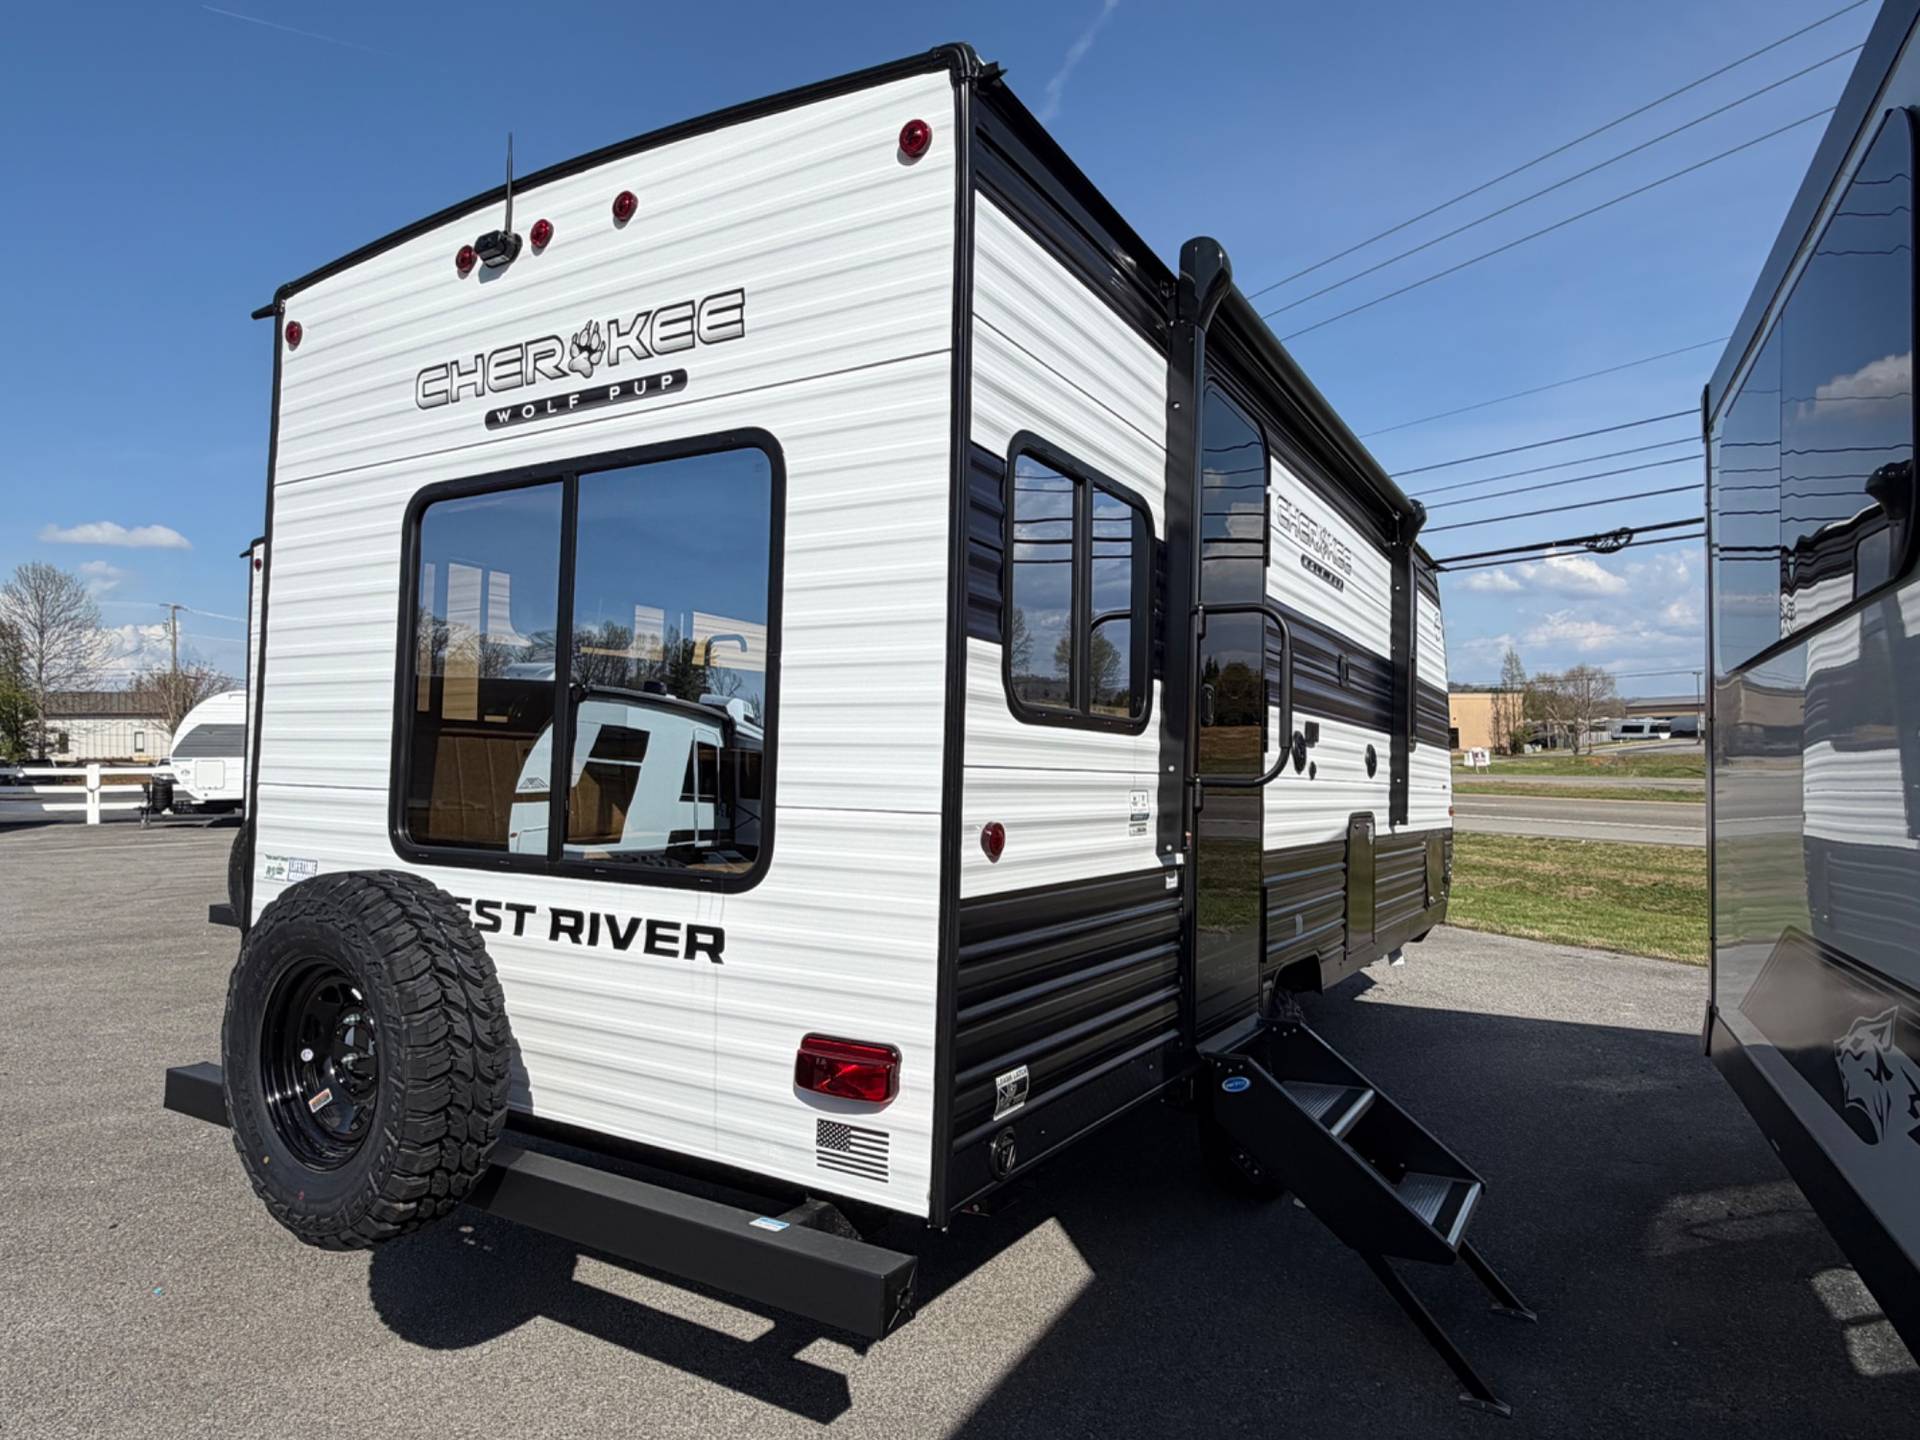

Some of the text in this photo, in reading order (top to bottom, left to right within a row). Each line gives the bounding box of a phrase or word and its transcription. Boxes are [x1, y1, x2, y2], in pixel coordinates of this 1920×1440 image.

[496, 375, 673, 423] WOLF PUP
[548, 907, 726, 965] RIVER
